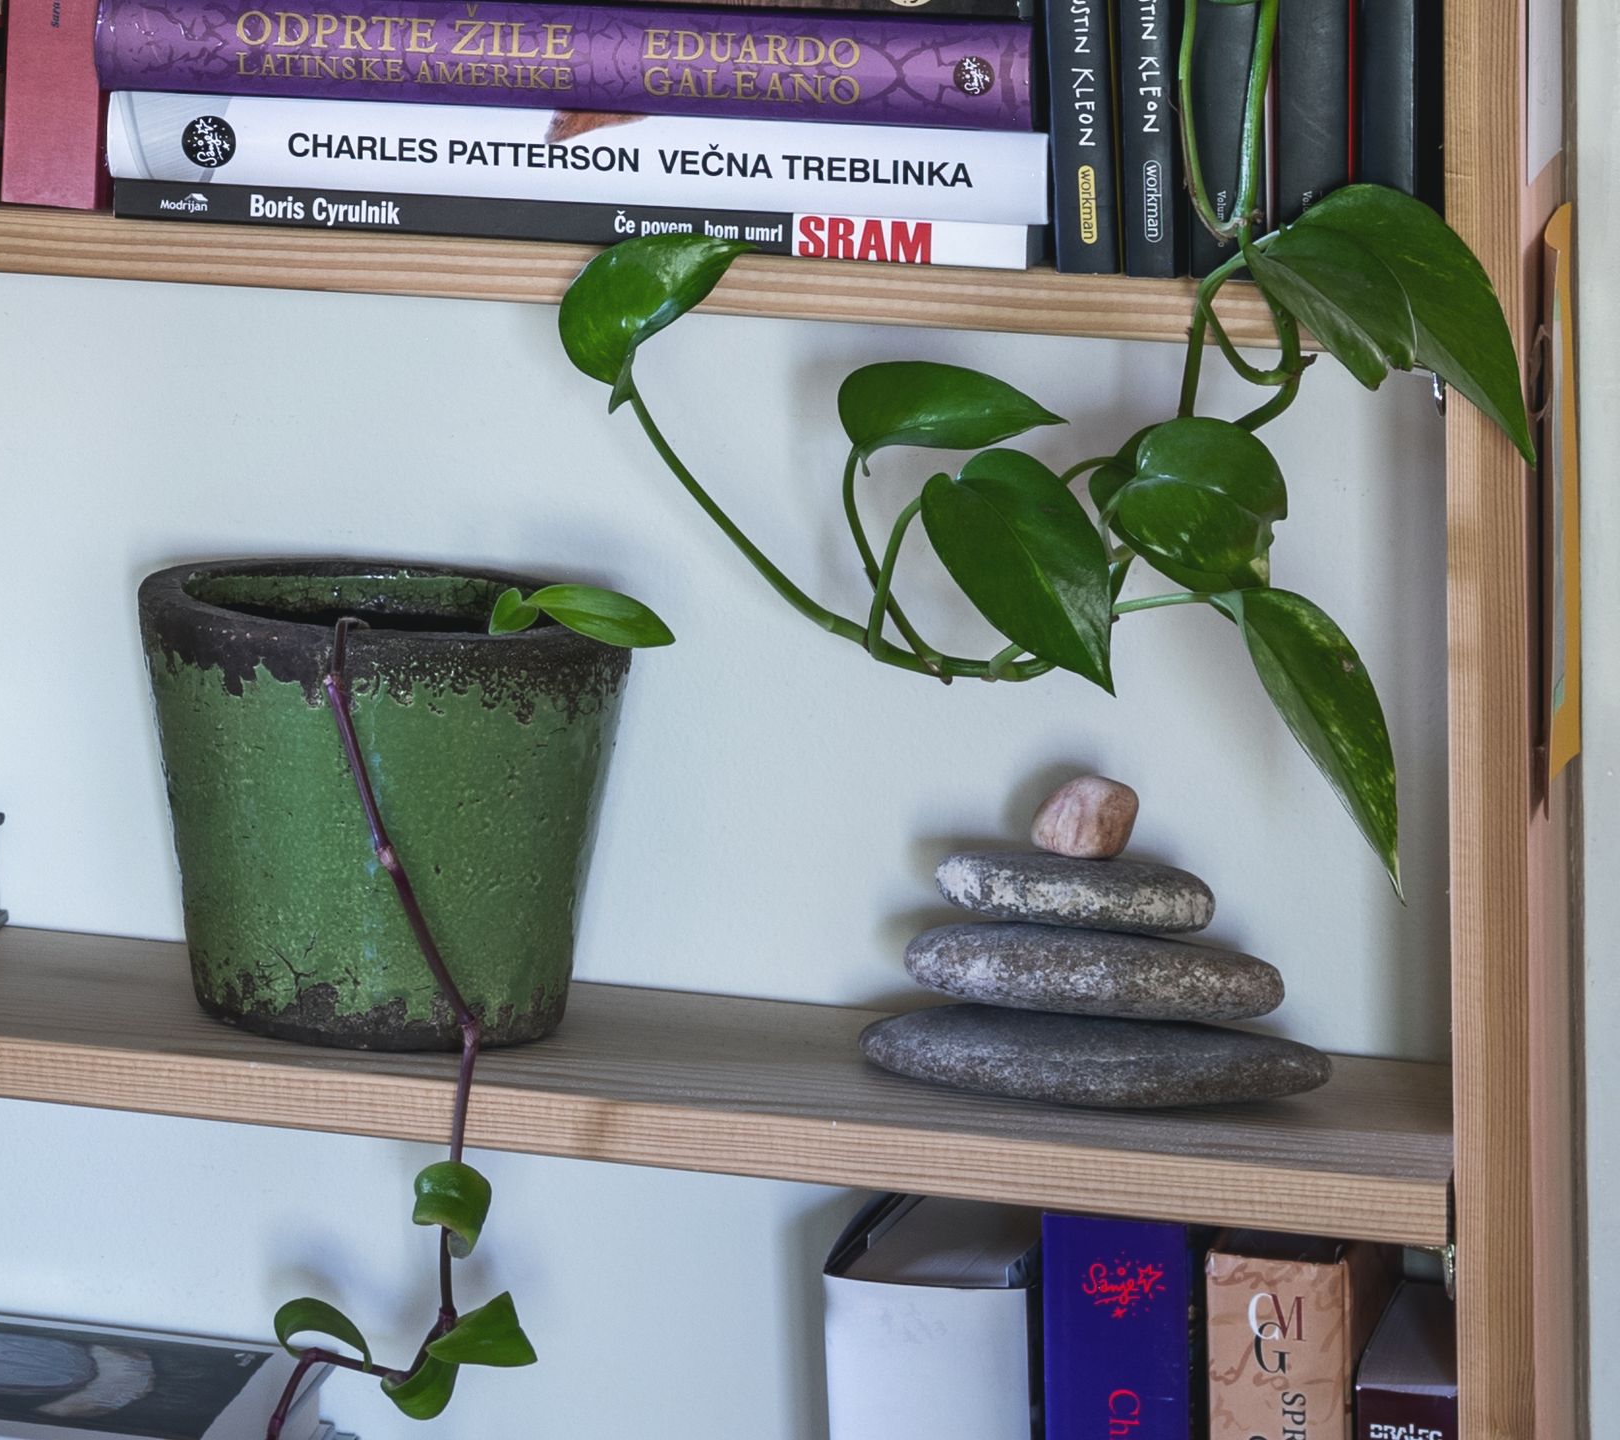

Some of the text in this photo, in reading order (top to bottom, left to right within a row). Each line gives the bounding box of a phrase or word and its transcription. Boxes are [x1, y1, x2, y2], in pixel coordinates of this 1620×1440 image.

[288, 132, 973, 188] CHARLES PATTERSON VEČNA TREBLINKA
[249, 194, 401, 227] Boris Cyrulnik
[798, 215, 933, 264] SRAM
